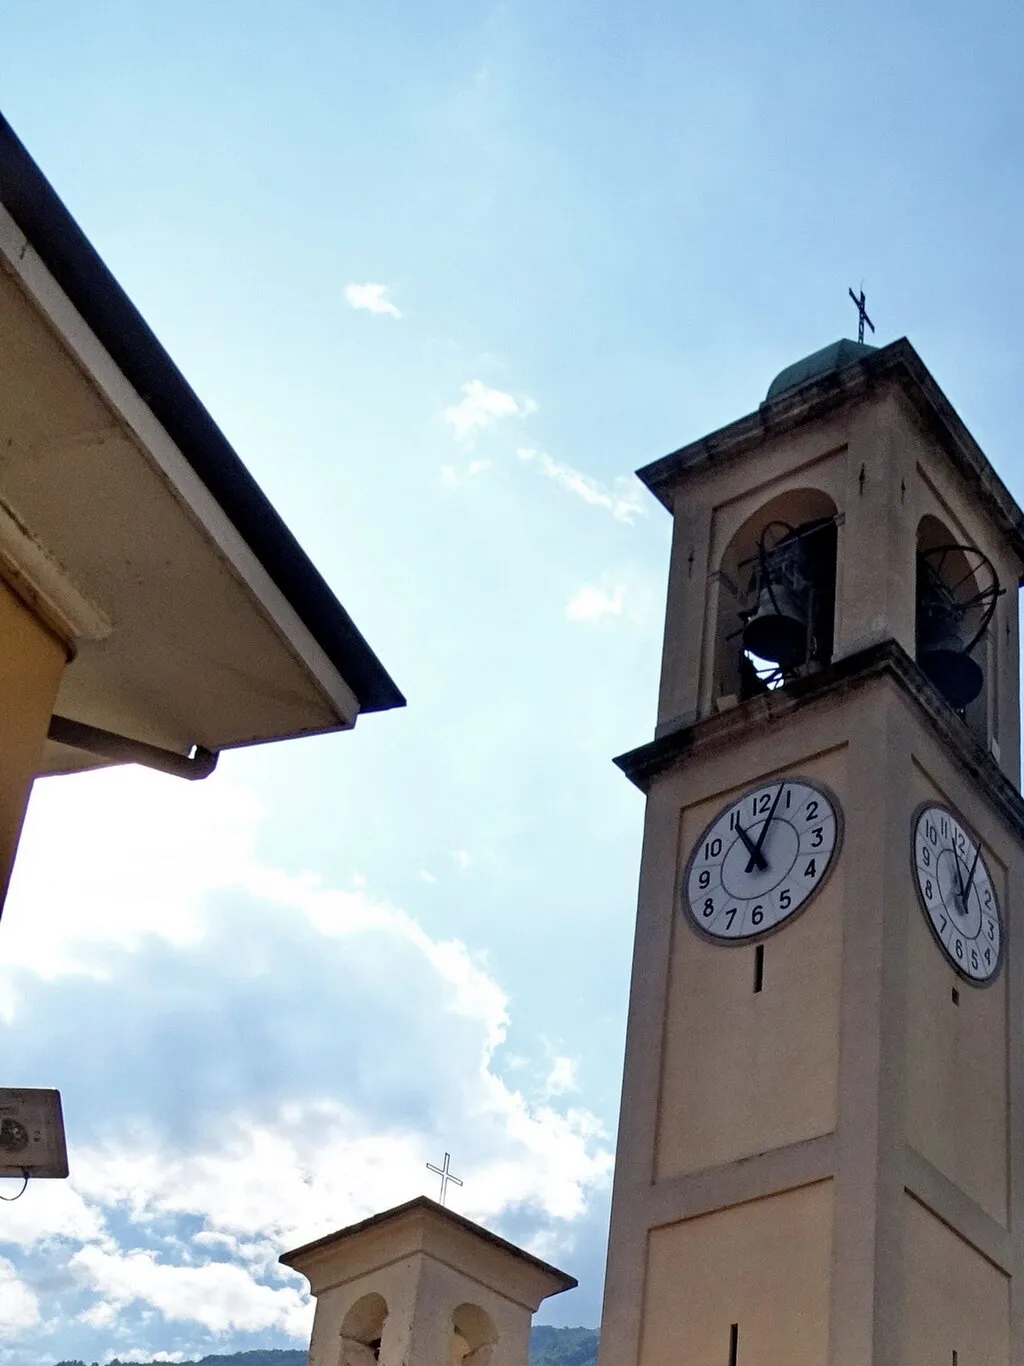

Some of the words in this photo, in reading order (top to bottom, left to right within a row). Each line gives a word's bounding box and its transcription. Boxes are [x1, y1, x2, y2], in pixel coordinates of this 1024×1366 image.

[753, 794, 771, 816] 12
[806, 802, 818, 821] 2
[730, 811, 740, 830] 11
[941, 818, 947, 839] 11
[811, 827, 823, 847] 3
[926, 820, 937, 845] 10
[955, 827, 966, 854] 12
[705, 839, 722, 860] 10
[922, 846, 930, 867] 9
[804, 859, 816, 878] 4
[699, 871, 710, 889] 9
[925, 880, 933, 900] 8
[703, 898, 714, 917] 8
[779, 889, 791, 909] 5
[985, 890, 992, 910] 2
[726, 908, 737, 930] 7
[752, 905, 764, 925] 6
[939, 913, 947, 934] 7
[987, 920, 994, 940] 3
[956, 939, 963, 959] 6
[984, 948, 990, 966] 4
[971, 949, 978, 970] 5
